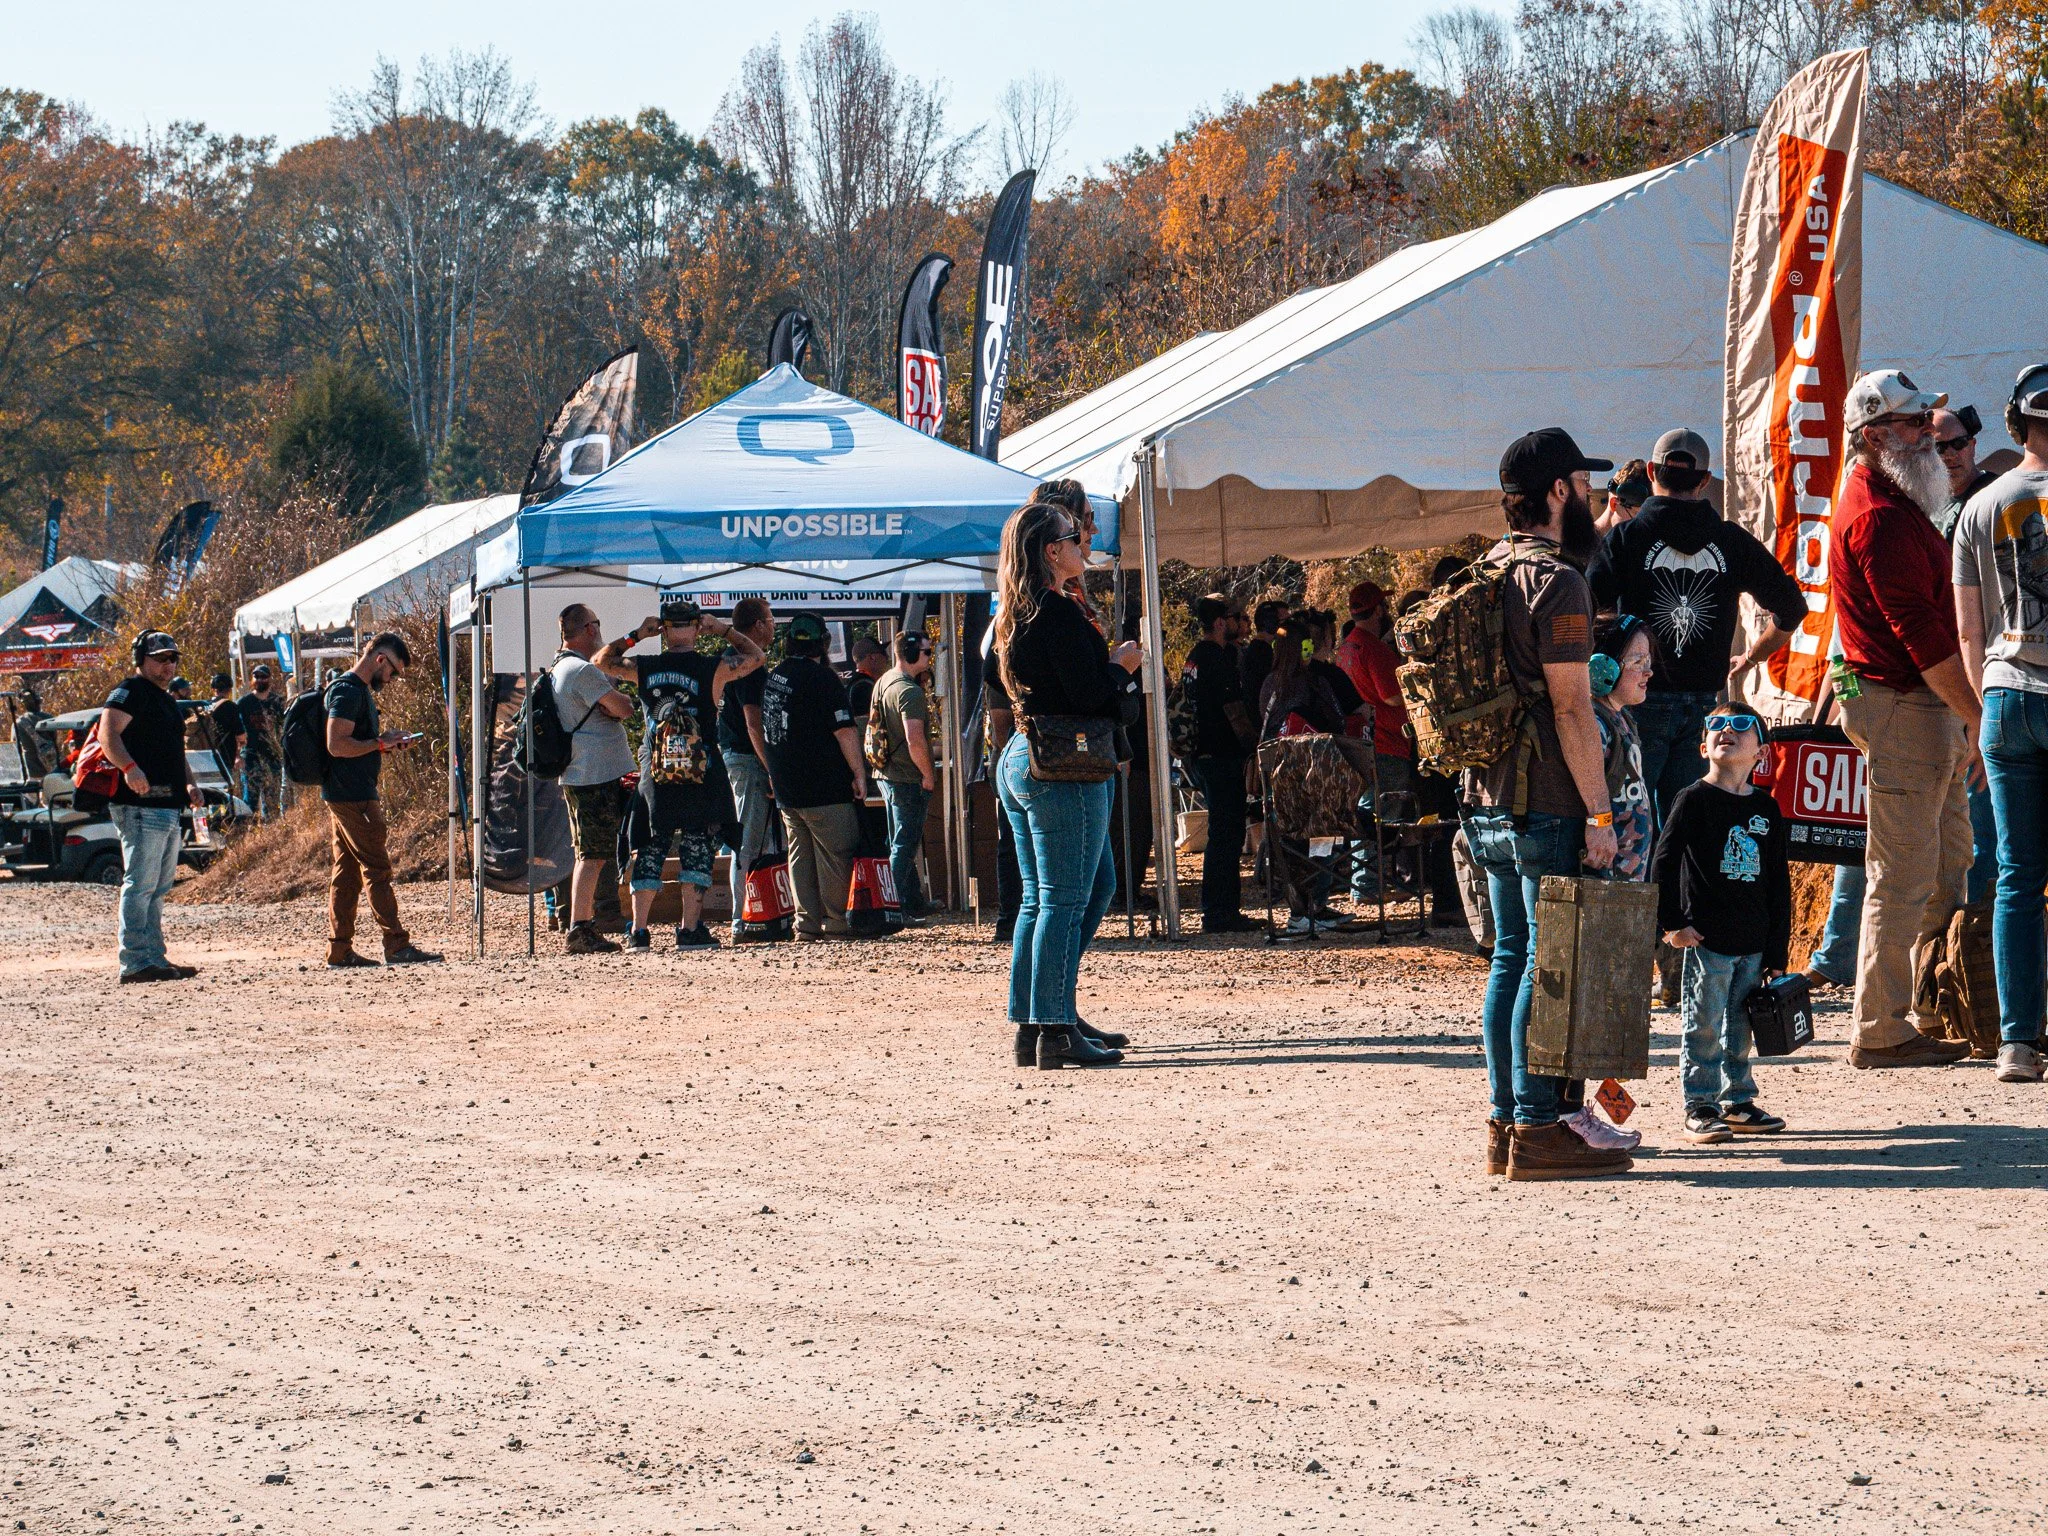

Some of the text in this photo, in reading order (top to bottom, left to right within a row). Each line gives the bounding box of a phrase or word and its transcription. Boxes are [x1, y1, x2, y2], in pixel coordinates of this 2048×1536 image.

[1807, 174, 1829, 260] USA
[737, 414, 855, 465] Q
[1788, 294, 1832, 656] norma
